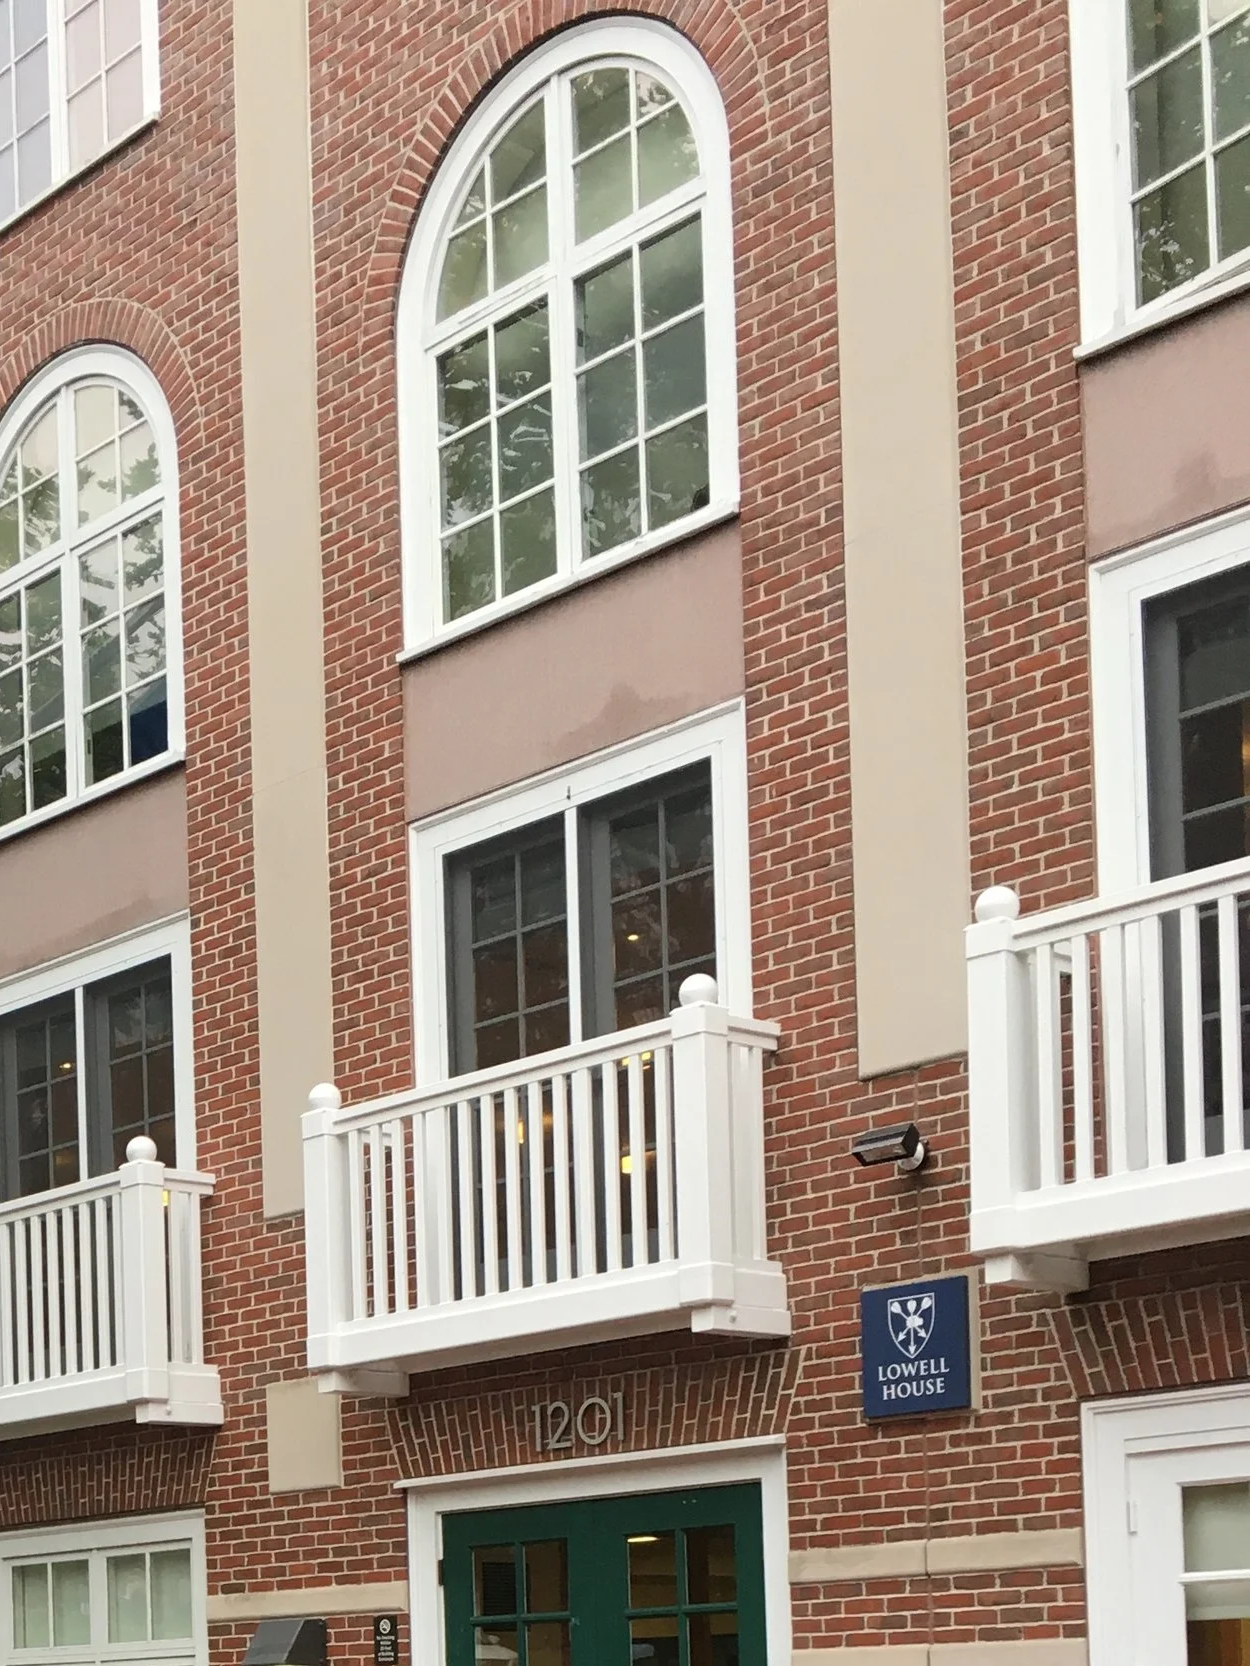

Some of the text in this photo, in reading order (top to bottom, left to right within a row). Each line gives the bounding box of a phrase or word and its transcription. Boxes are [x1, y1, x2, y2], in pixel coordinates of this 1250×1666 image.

[879, 1358, 949, 1381] LOWELL
[883, 1378, 945, 1400] HOUSE
[531, 1392, 624, 1452] 1201
